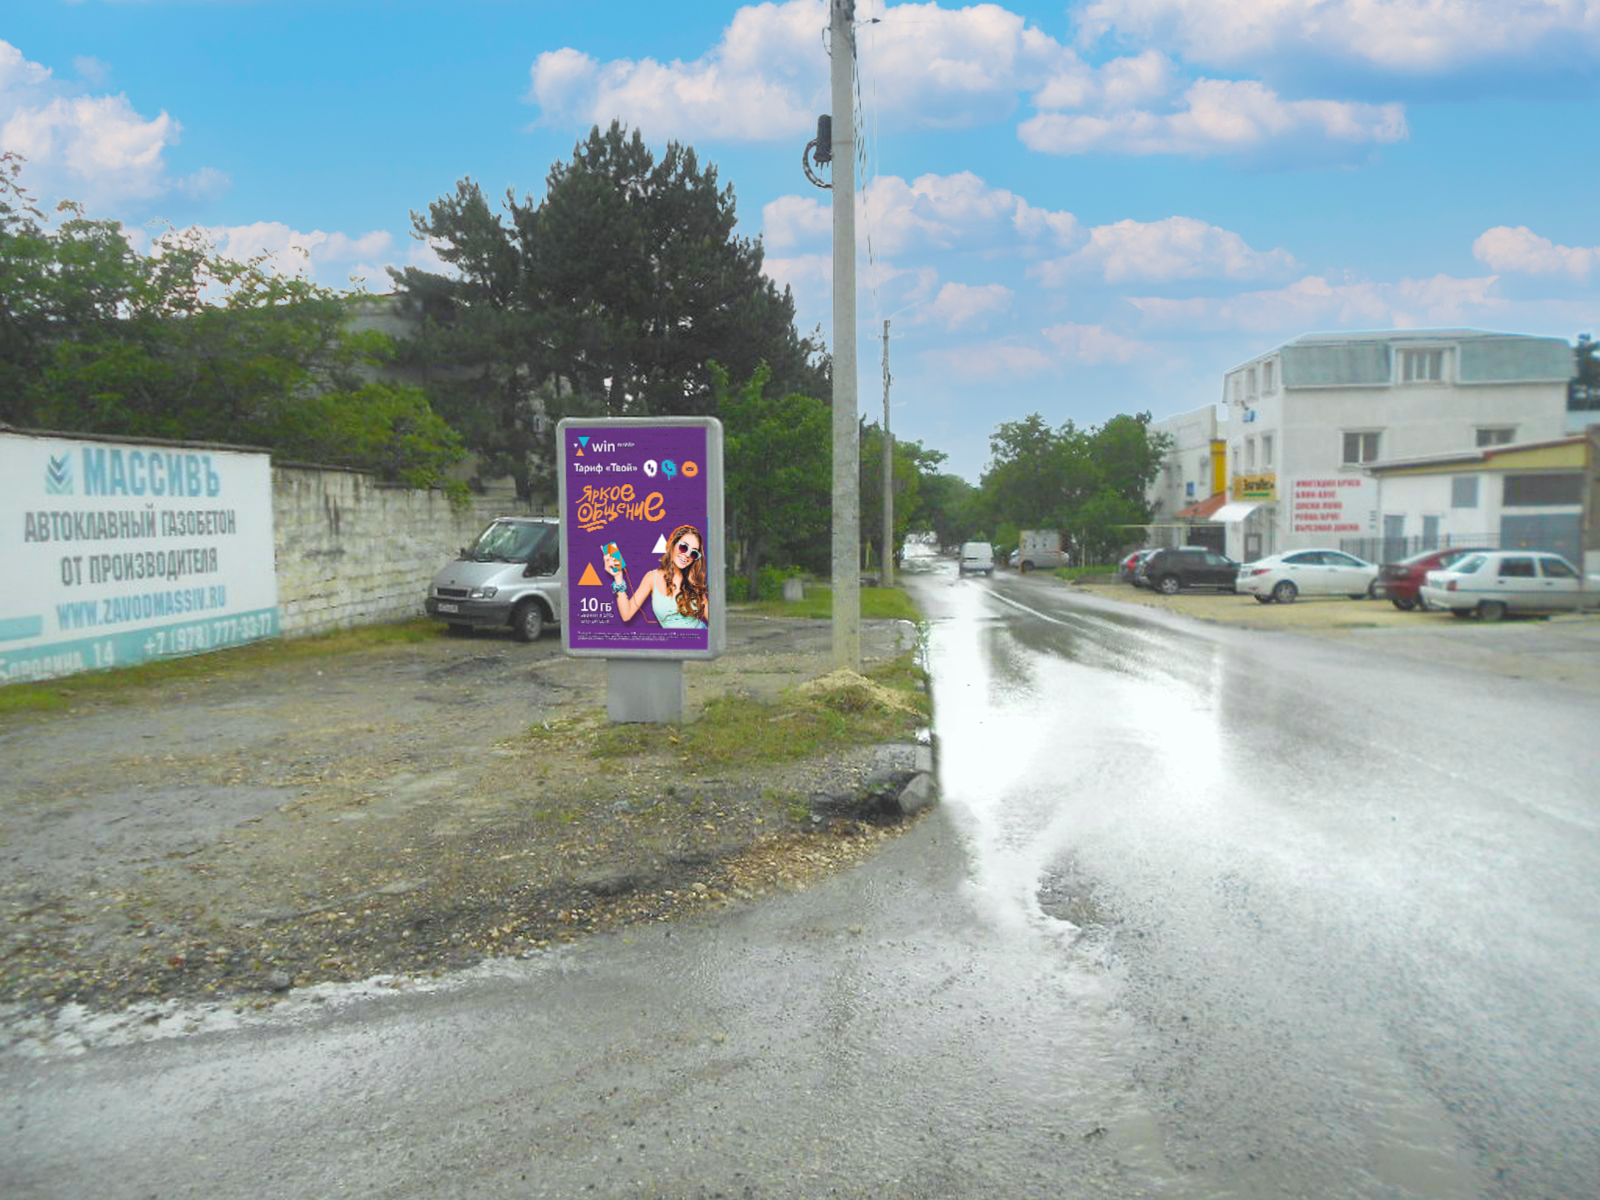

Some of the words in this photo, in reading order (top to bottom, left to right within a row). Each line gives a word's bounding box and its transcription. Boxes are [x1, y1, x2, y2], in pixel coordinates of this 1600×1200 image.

[592, 440, 615, 452] win
[82, 448, 220, 497] МАССИВЪ
[574, 463, 603, 474] Тариф
[606, 463, 638, 472] «Твой»
[24, 503, 157, 542] АВТОКЛАВНЫЙ
[162, 510, 236, 537] ГАЗОБЕТОН
[61, 555, 82, 586] ОТ
[90, 548, 218, 584] ПРОИЗВОДИТЕЛЯ
[57, 585, 226, 630] WWW.ZAVODMASSIV.RU
[580, 598, 598, 611] 10
